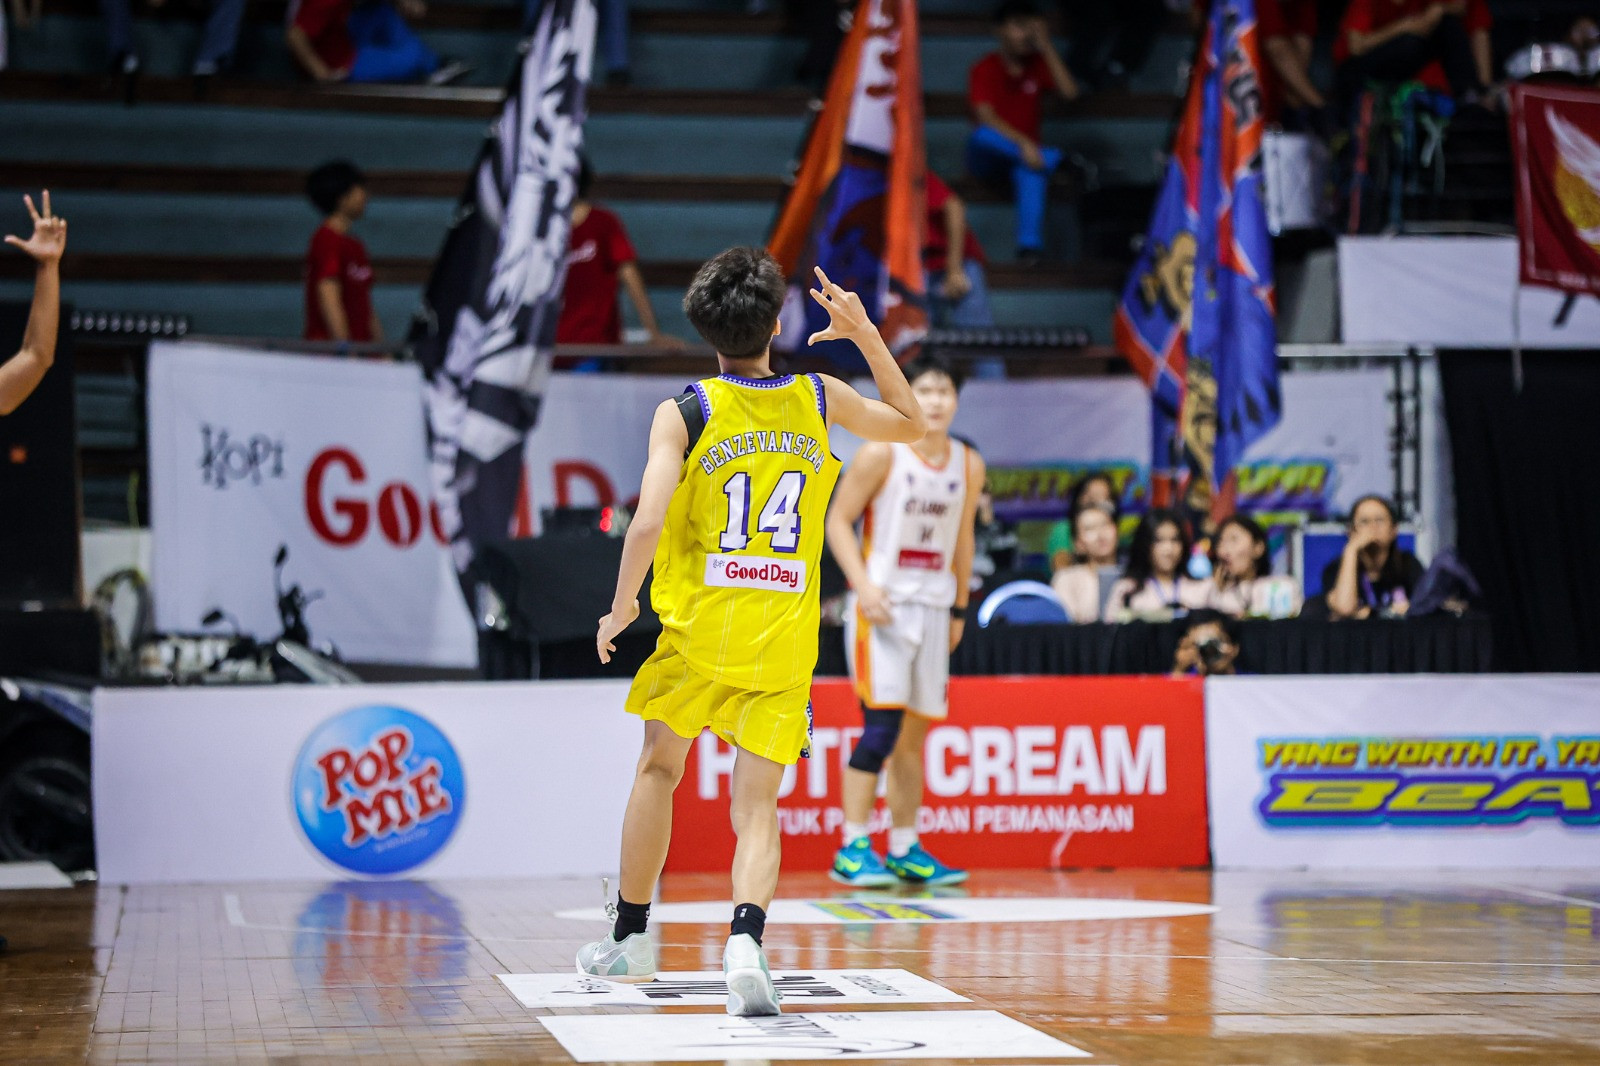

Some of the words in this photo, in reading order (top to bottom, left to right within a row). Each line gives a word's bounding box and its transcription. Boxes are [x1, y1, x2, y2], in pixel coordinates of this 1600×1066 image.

[699, 431, 825, 475] BENZEVANSYAH
[719, 471, 806, 553] 14
[318, 732, 407, 808] POP
[926, 724, 1167, 796] CREAM
[1263, 741, 1359, 768] YANG
[1367, 741, 1497, 768] WORTH
[346, 765, 449, 843] MIE
[916, 805, 971, 833] DAN
[973, 804, 1134, 833] PEMANASAN
[1266, 777, 1600, 813] BeA
